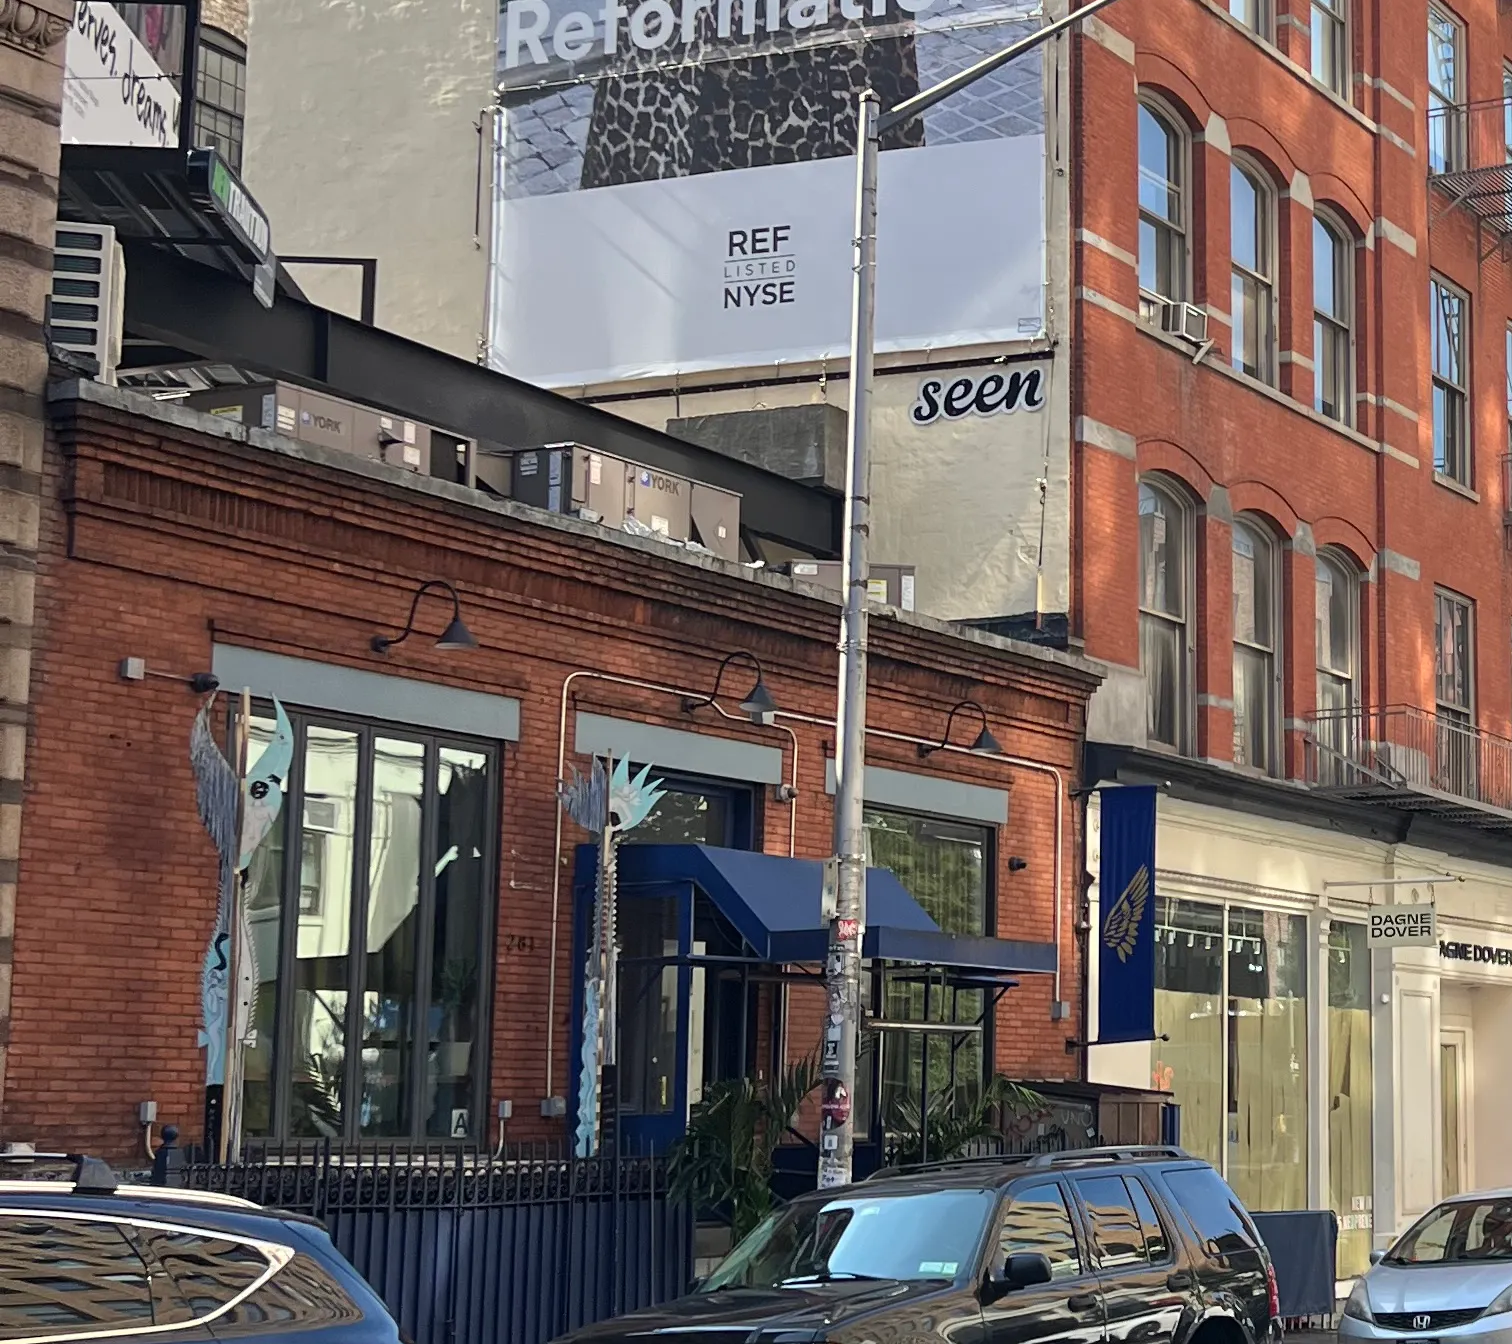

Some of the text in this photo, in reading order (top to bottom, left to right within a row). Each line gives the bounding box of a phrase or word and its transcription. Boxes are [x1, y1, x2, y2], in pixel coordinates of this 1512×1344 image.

[121, 37, 169, 146] dreams.
[729, 225, 791, 257] REF
[724, 259, 796, 278] LISTED
[724, 281, 795, 309] NYSE
[913, 369, 1043, 422] seen
[651, 476, 680, 496] YORK
[1371, 913, 1432, 926] DAGNE
[1371, 926, 1432, 938] DOVER
[1439, 940, 1473, 961] AGNE
[454, 1113, 468, 1134] A
